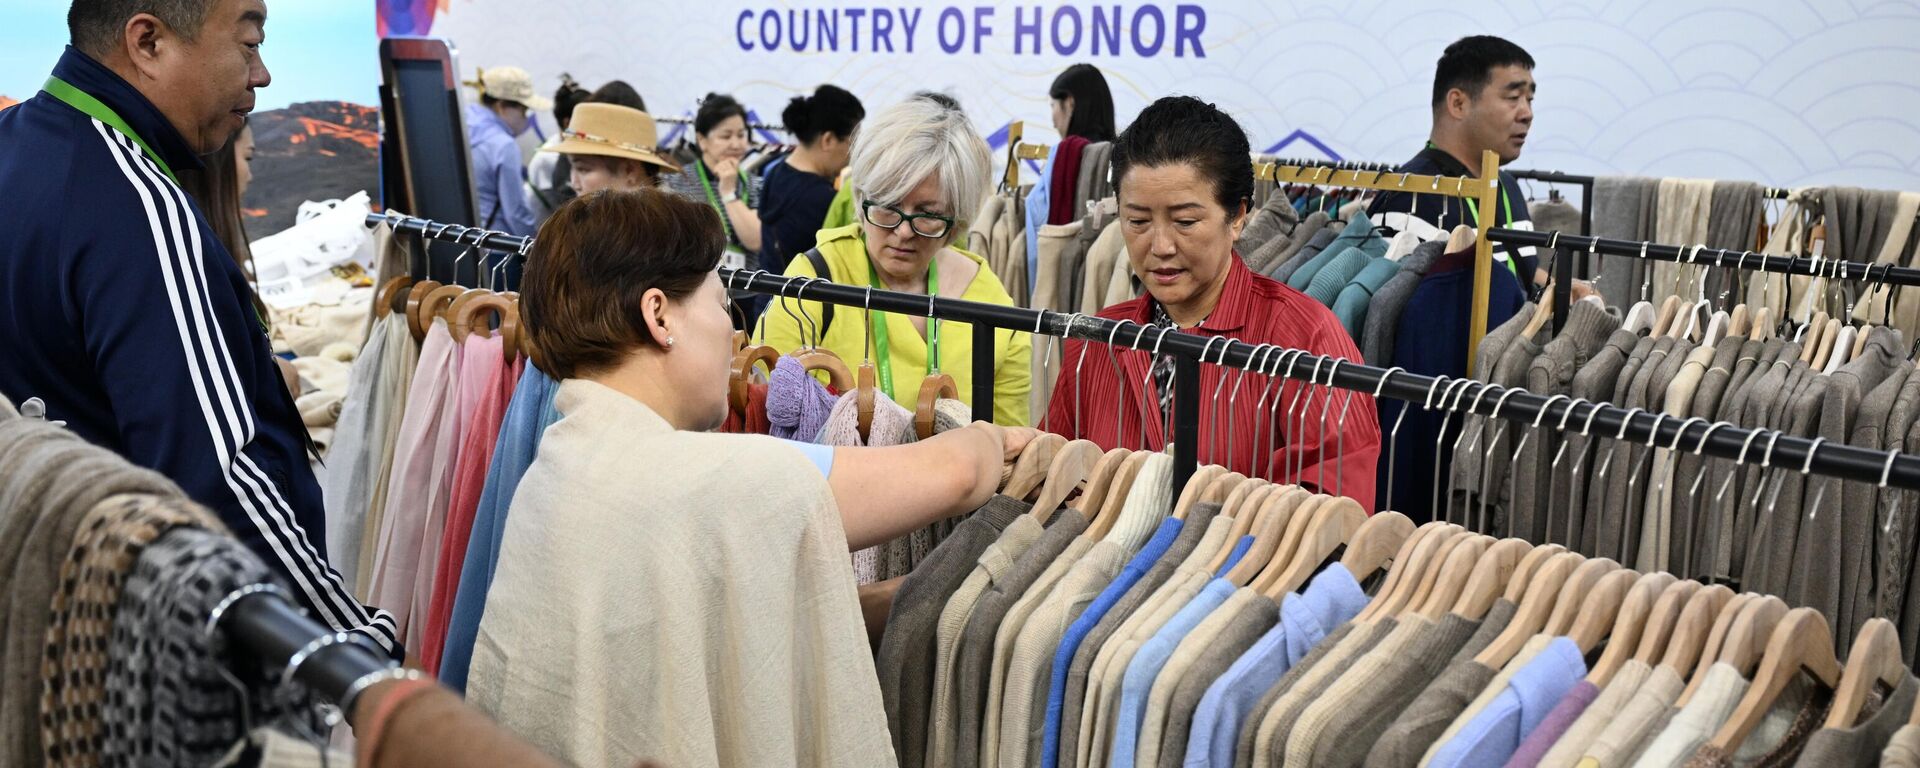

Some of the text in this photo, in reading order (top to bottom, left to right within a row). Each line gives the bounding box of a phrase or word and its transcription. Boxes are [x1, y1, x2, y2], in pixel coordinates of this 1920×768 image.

[736, 3, 1208, 59] COUNTRY OF HONOR
